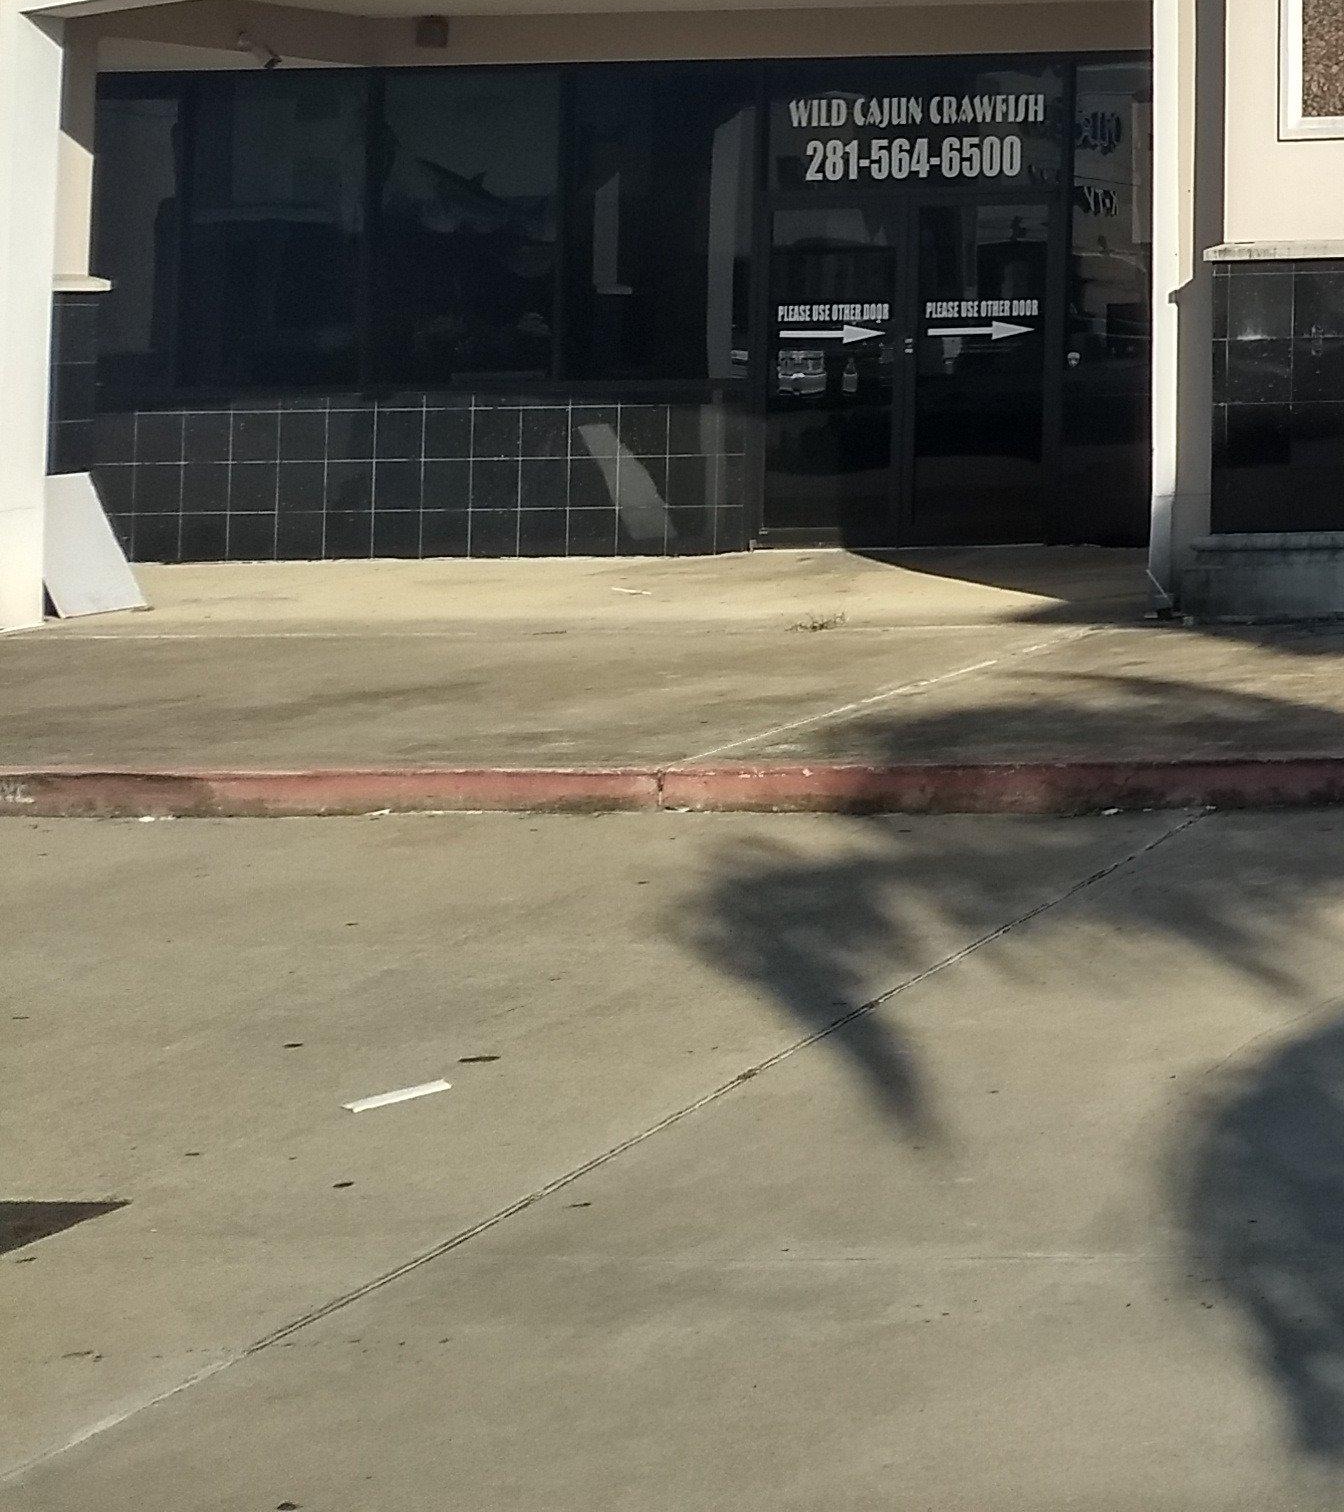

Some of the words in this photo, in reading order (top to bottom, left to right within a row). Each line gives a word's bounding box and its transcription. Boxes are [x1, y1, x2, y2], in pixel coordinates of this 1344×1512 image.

[789, 99, 847, 128] WILD
[853, 96, 923, 127] CAJUN
[929, 94, 1045, 124] CRAWFISH
[805, 135, 1022, 181] 281-564-6500
[778, 305, 810, 322] PLEASE
[812, 304, 830, 321] USE
[832, 304, 861, 321] OTHER
[863, 303, 889, 320] DOOR
[926, 302, 959, 318] PLEASE
[961, 301, 978, 317] USE
[981, 300, 1011, 317] OTHER
[1013, 299, 1038, 316] DOOR
